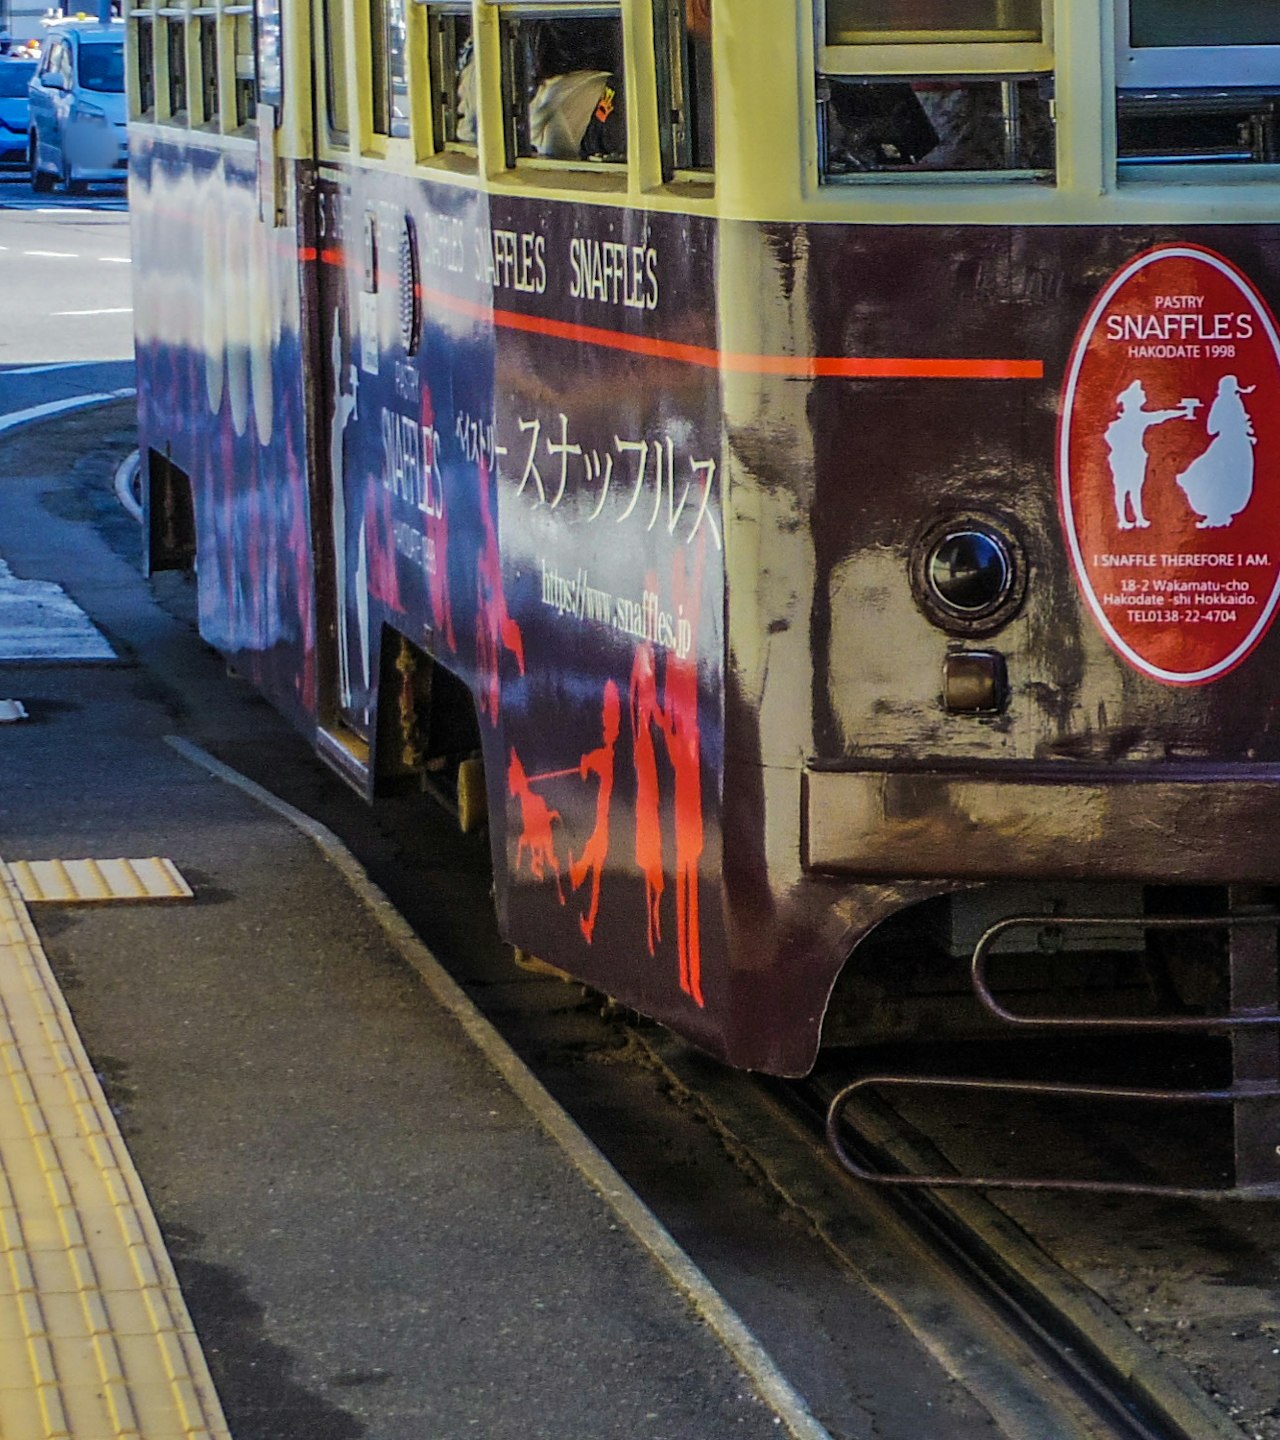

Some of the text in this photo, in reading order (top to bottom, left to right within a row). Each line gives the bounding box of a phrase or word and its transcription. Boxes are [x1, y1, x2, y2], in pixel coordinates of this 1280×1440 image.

[1154, 295, 1205, 309] PASTRY
[1127, 344, 1237, 359] HAKODATE 1998
[1101, 553, 1158, 567] SNAFFLE
[1160, 553, 1236, 567] THEREFORE
[1237, 553, 1243, 567] I
[1121, 579, 1250, 592] 18-2 Wakamatu-cho
[1103, 593, 1165, 606] Hakodate
[1127, 609, 1237, 623] TEL0138-22-4704
